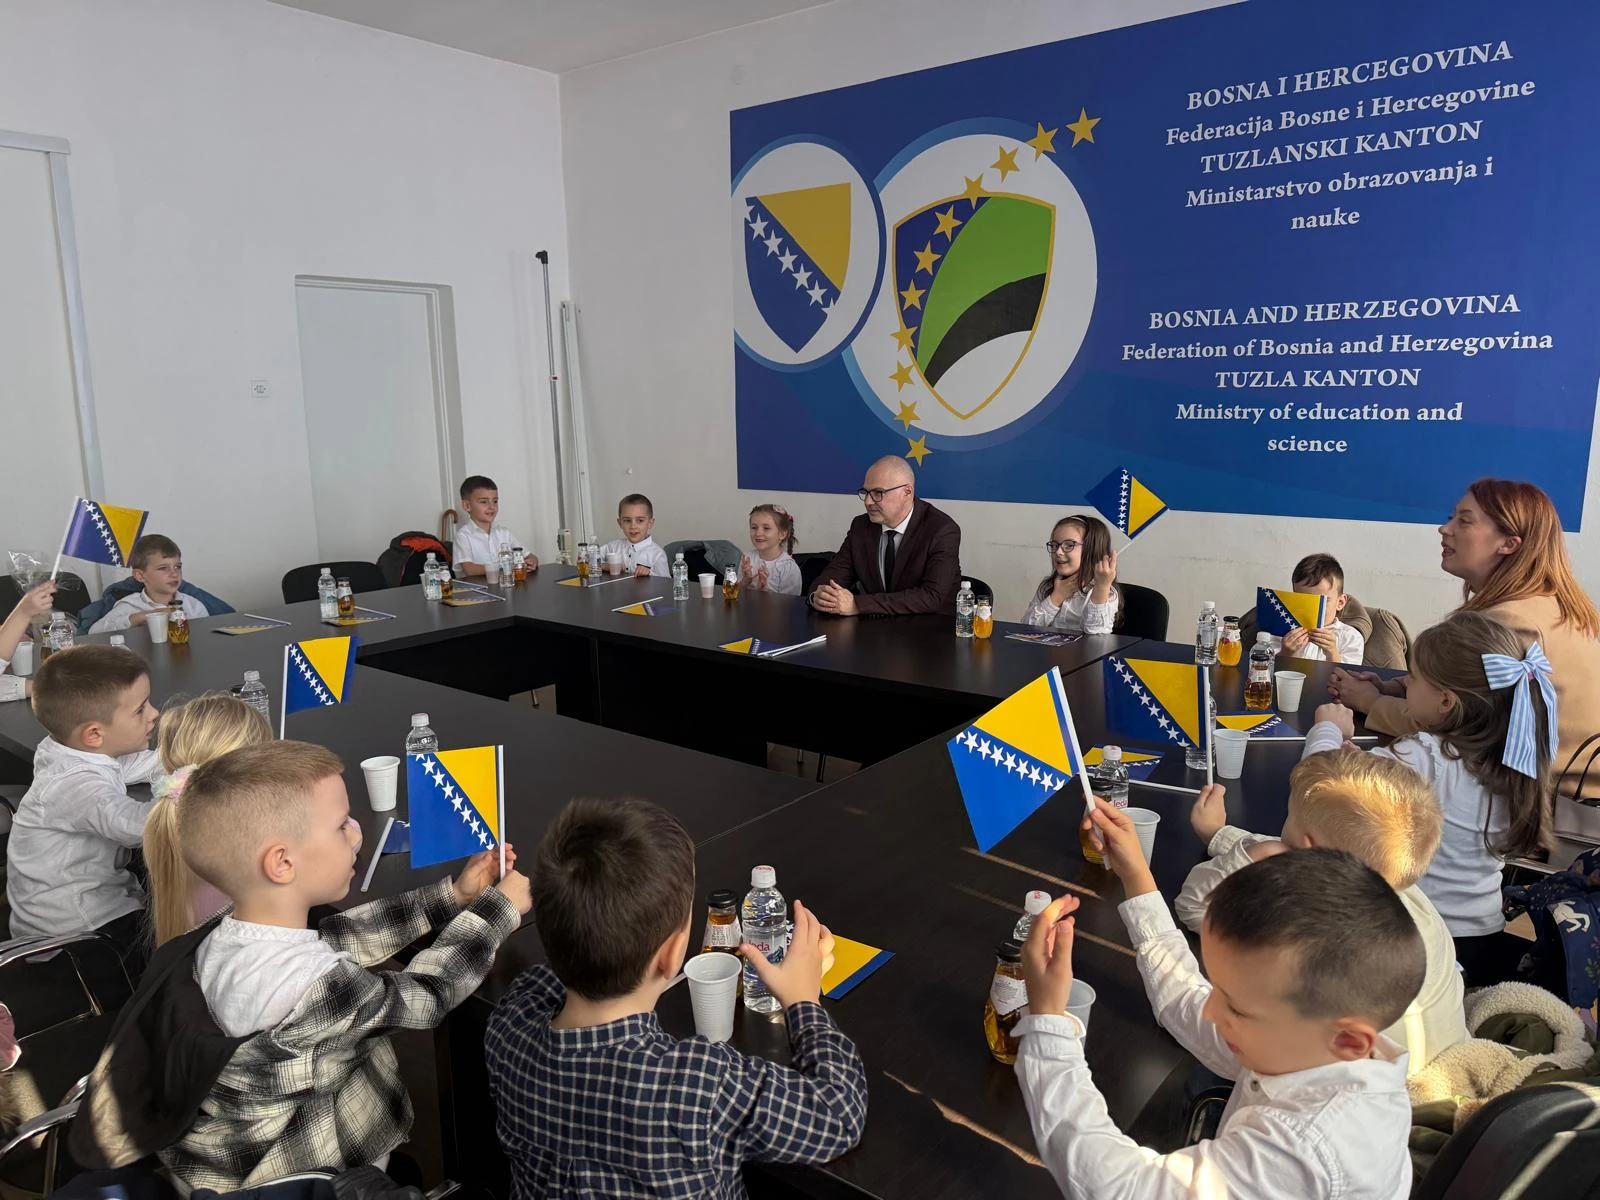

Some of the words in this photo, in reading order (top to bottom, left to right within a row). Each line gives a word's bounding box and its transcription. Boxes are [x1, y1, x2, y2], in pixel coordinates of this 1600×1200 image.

[1187, 81, 1273, 110] BOSNA
[1277, 77, 1289, 96] I
[1293, 41, 1514, 94] HERCEGOVINA
[1166, 116, 1273, 146] Federacija
[1279, 109, 1350, 130] Bosne
[1355, 101, 1364, 119] i
[1370, 78, 1536, 117] Hercegovine
[1200, 137, 1349, 174] TUZLANSKI
[1354, 120, 1483, 155] KANTON
[1185, 179, 1322, 208] Ministarstvo
[1328, 159, 1478, 192] obrazovanja
[1484, 157, 1493, 176] i
[1290, 206, 1361, 230] nauke
[1149, 308, 1239, 330] BOSNIA
[1242, 305, 1298, 325] AND
[1303, 294, 1521, 322] HERZEGOVINA
[1121, 341, 1228, 361] Federation
[1233, 338, 1258, 357] of
[1259, 337, 1334, 356] Bosnia
[1340, 335, 1384, 354] and
[1390, 330, 1554, 357] Herzegovina
[1215, 371, 1297, 389] TUZLA
[1303, 368, 1422, 387] KANTON
[1175, 403, 1265, 425] Ministry
[1269, 402, 1295, 420] of
[1297, 401, 1411, 421] education
[1417, 401, 1464, 421] and
[1267, 435, 1348, 453] science
